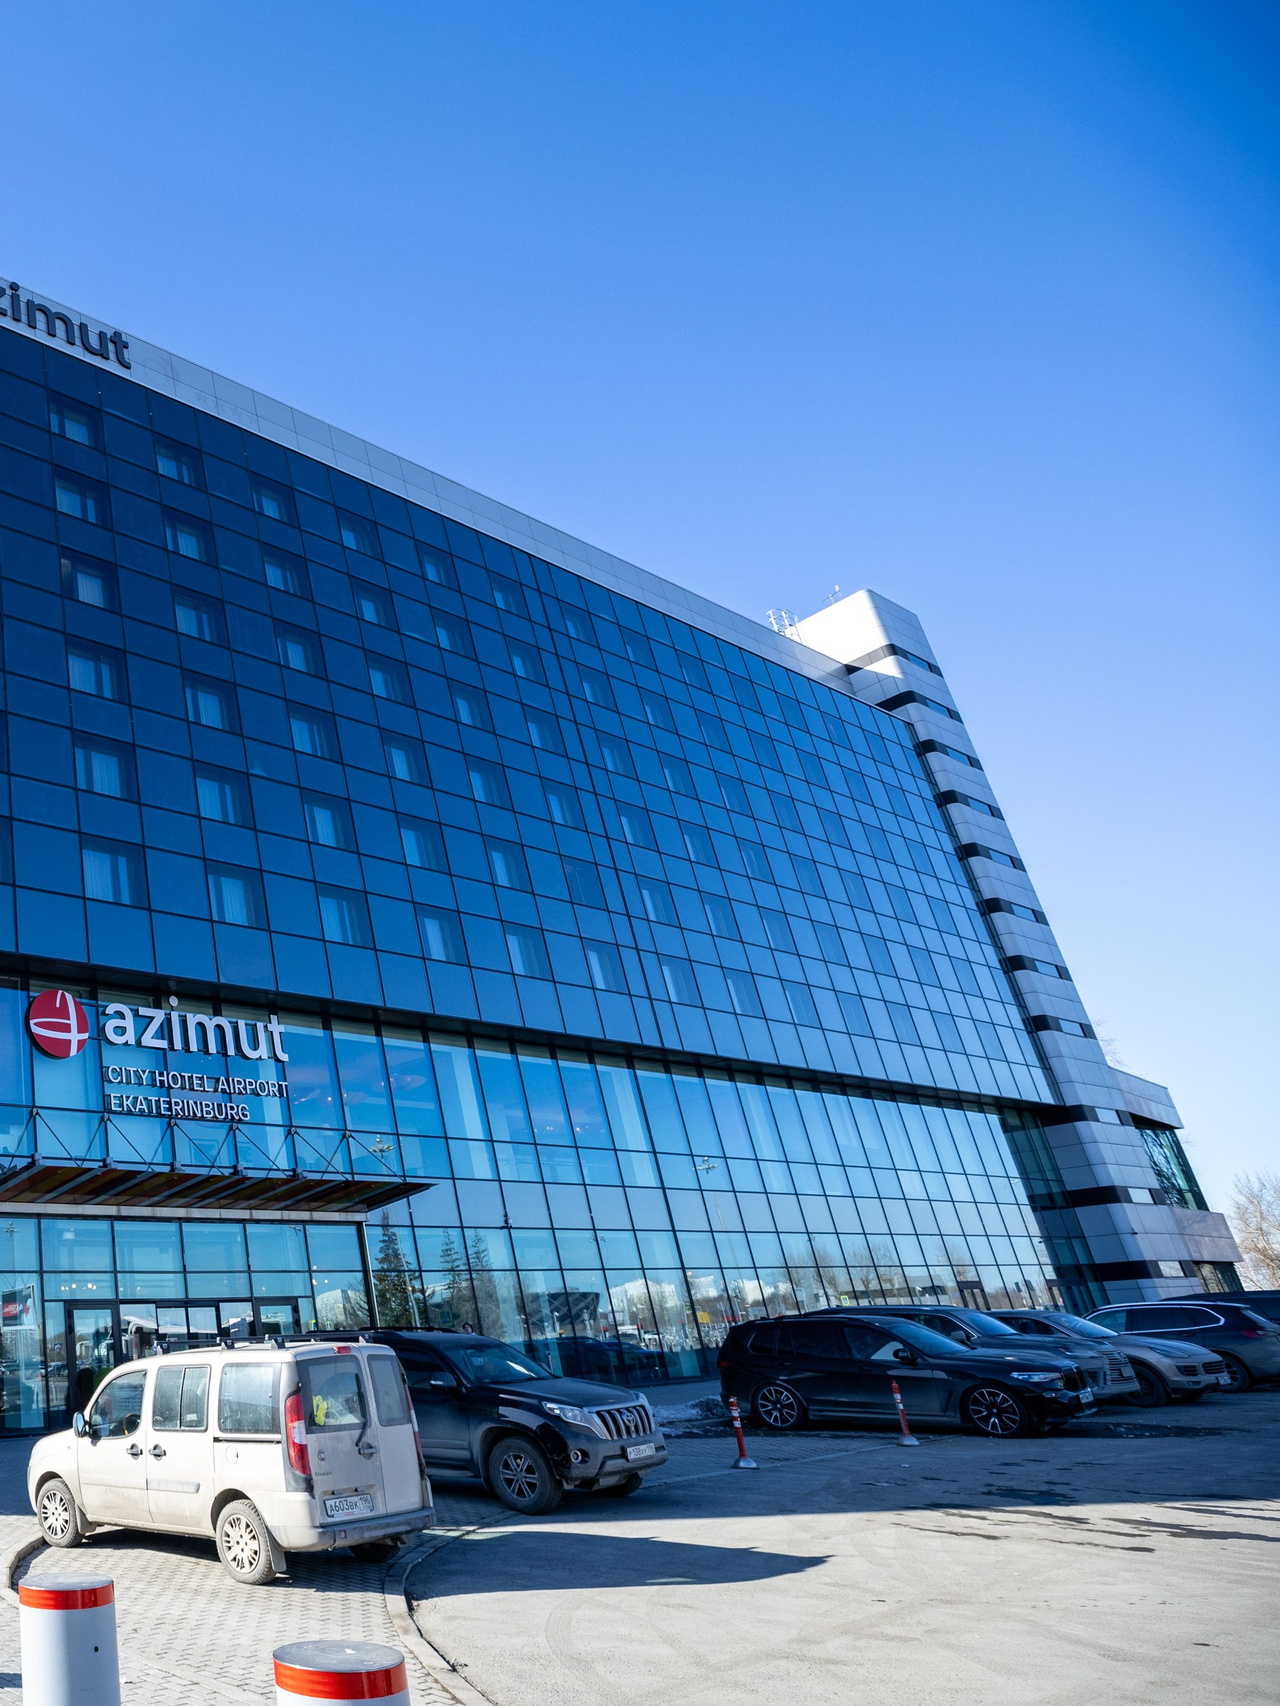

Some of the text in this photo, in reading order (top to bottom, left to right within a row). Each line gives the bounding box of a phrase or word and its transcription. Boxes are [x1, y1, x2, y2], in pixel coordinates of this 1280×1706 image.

[104, 995, 289, 1062] azimut
[107, 1065, 289, 1098] CITY HOTEL AIRPORT
[109, 1093, 250, 1121] EKATERINBURG
